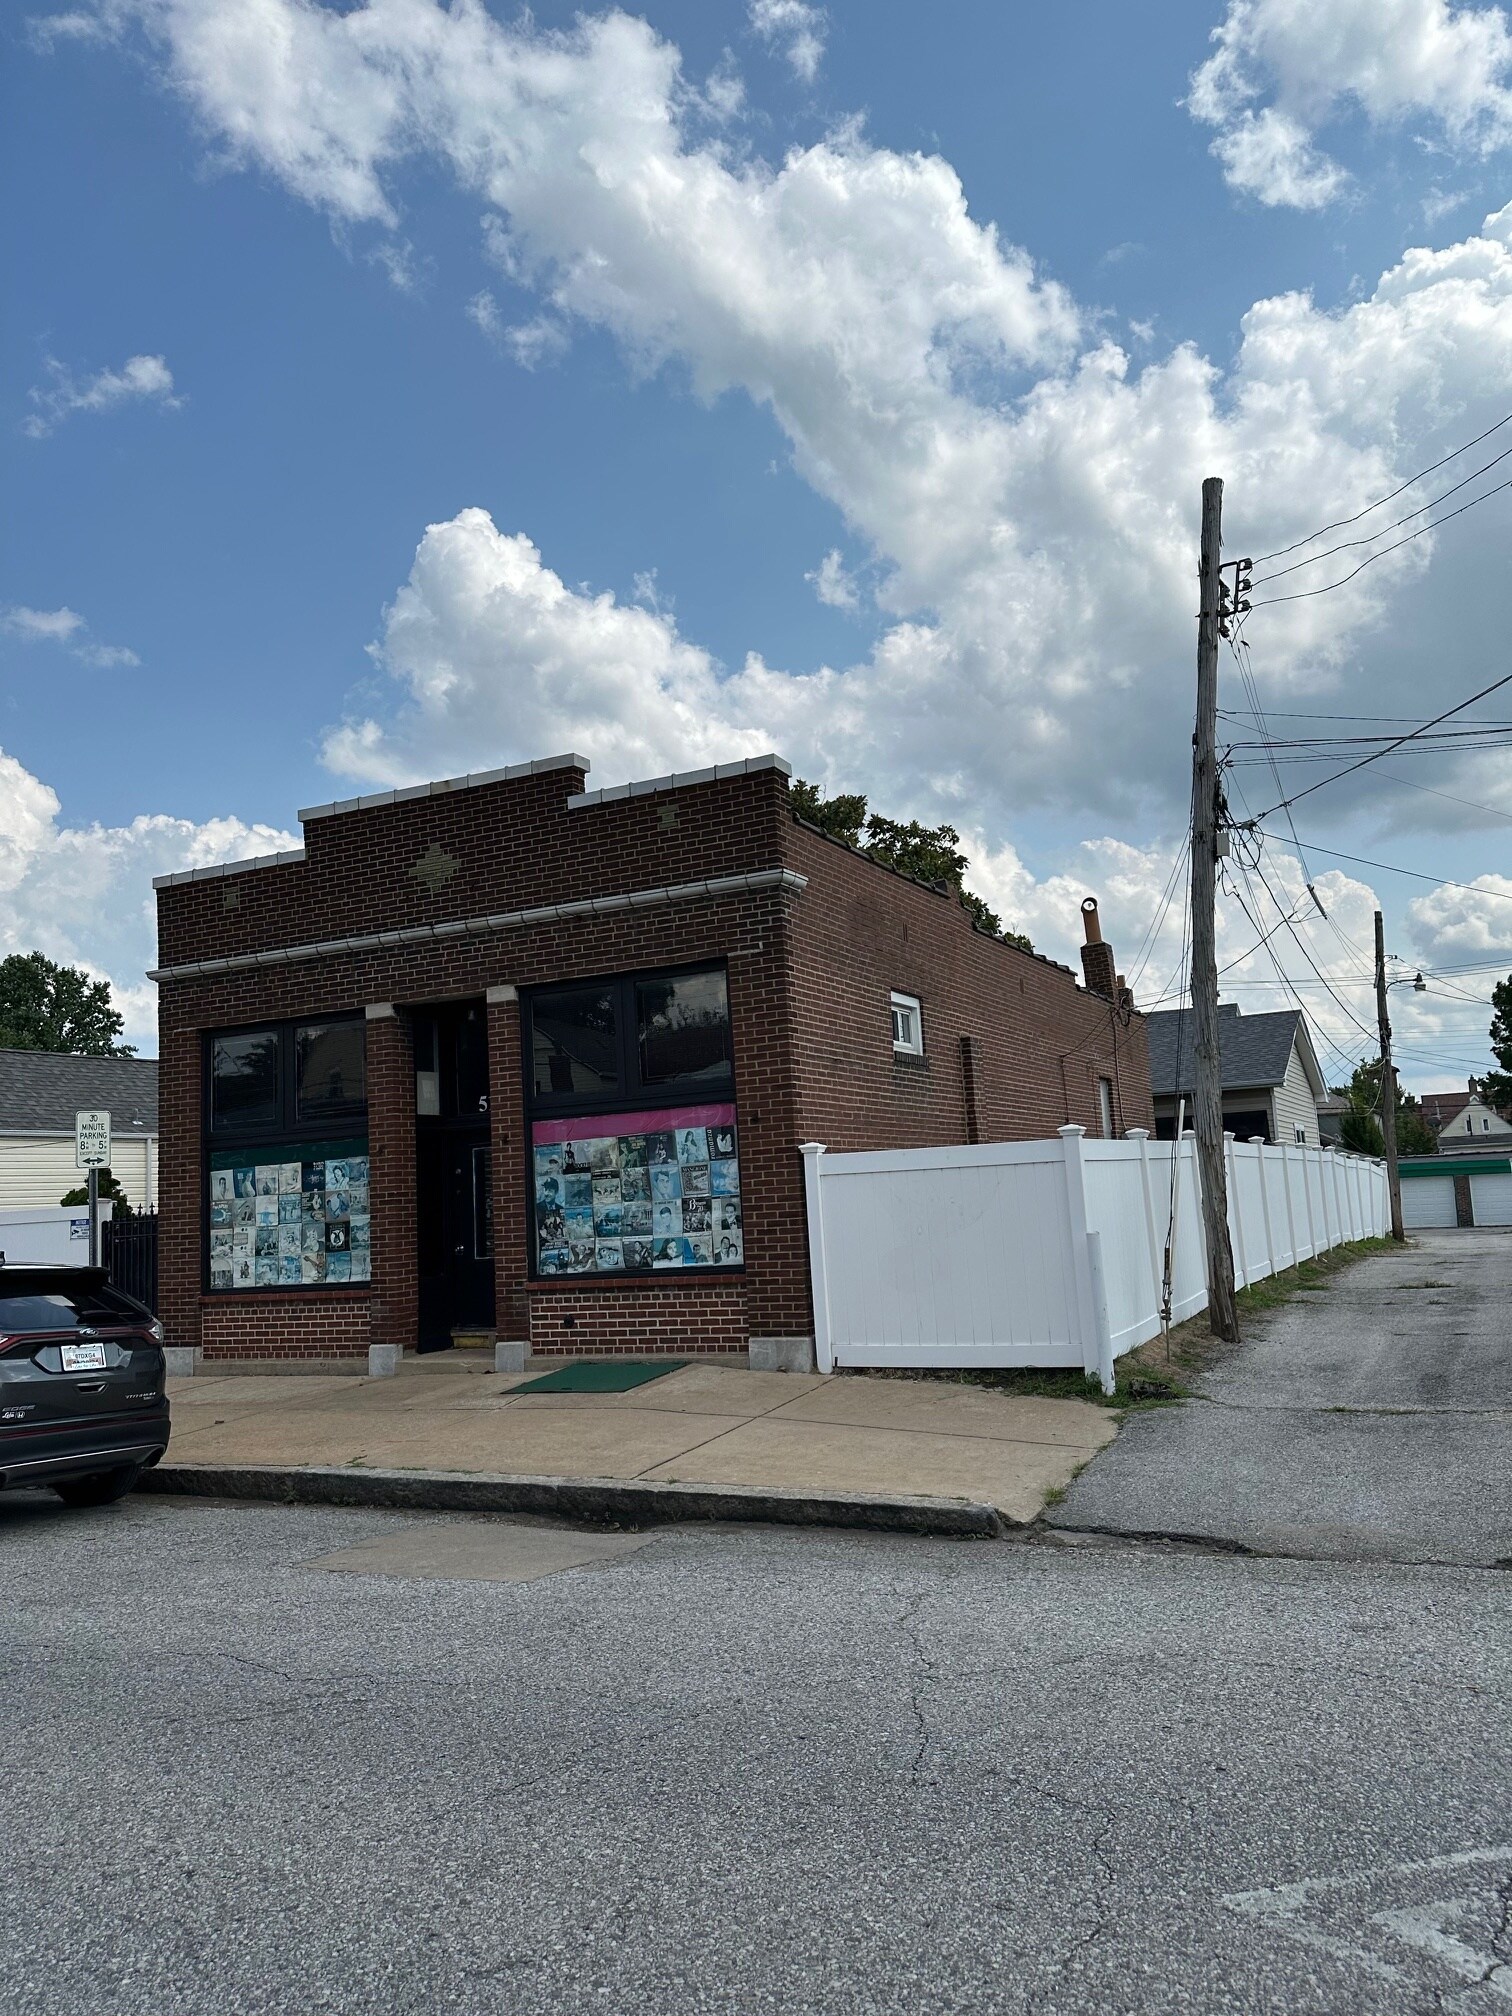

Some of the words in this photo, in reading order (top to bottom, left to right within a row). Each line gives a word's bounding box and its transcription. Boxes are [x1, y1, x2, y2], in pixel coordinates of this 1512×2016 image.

[89, 1114, 98, 1122] 30
[82, 1123, 105, 1131] MINUTE
[80, 1132, 107, 1140] PARKING
[80, 1141, 86, 1150] 8
[98, 1140, 104, 1150] 5
